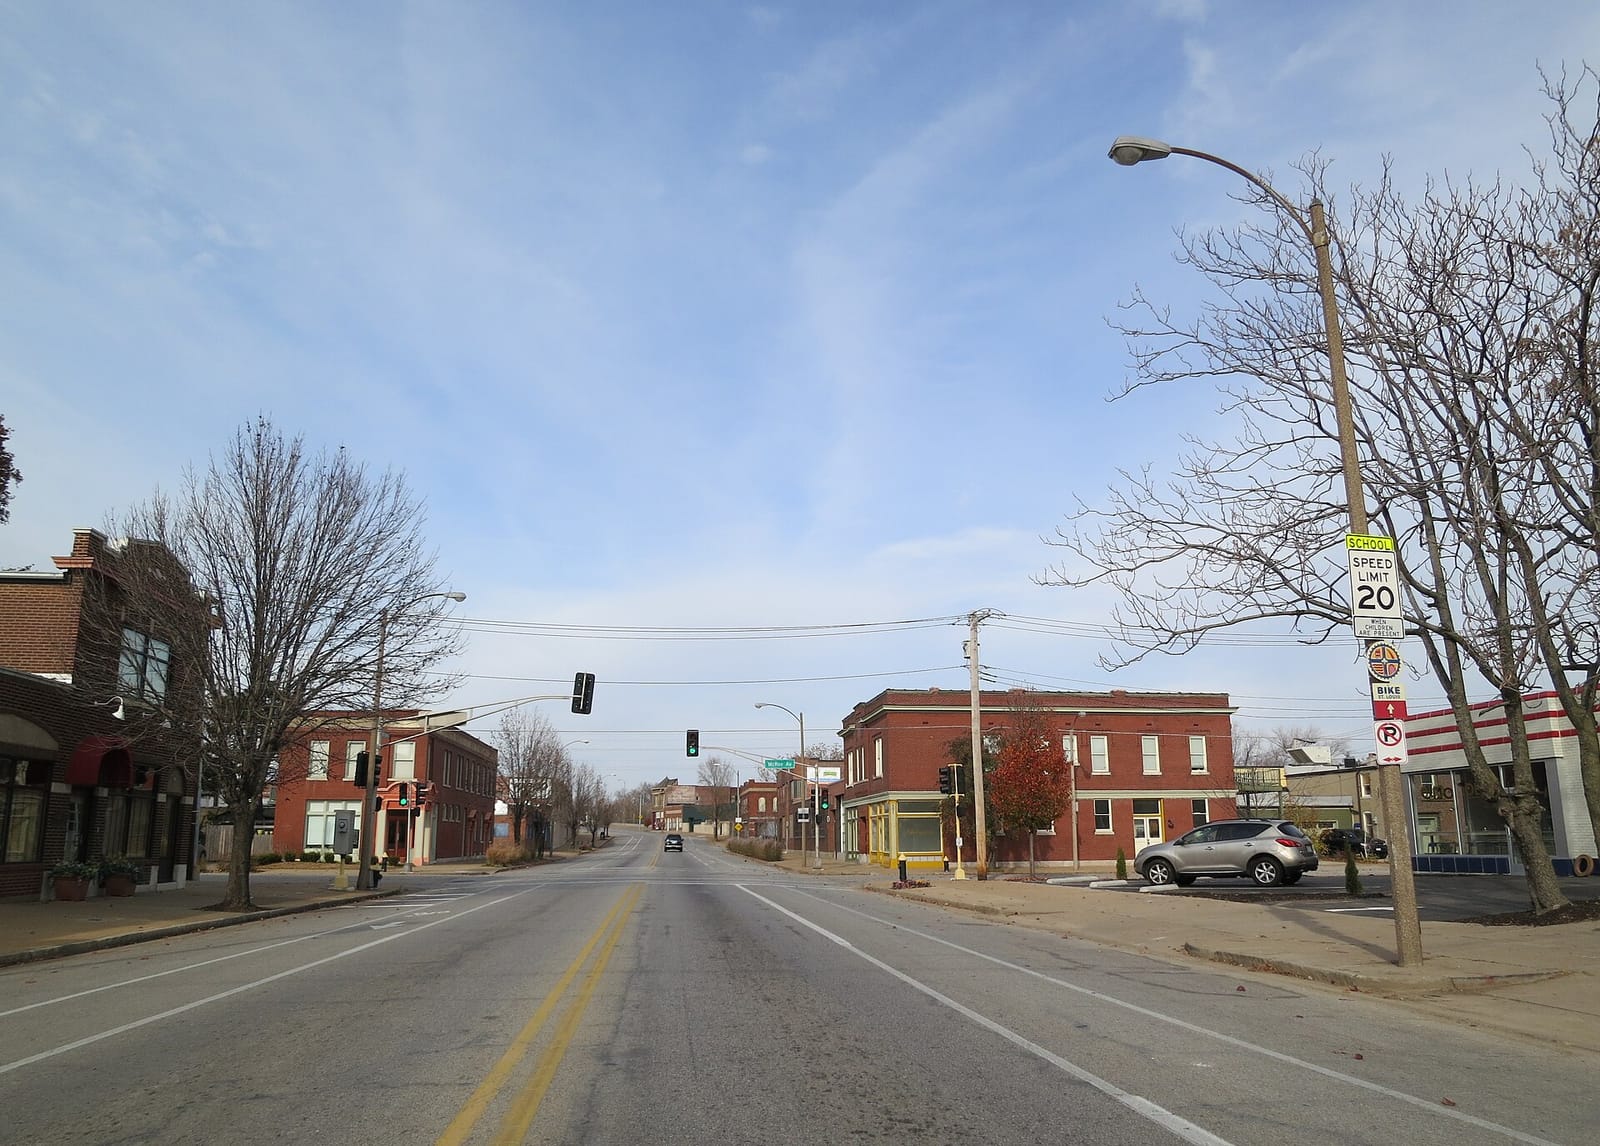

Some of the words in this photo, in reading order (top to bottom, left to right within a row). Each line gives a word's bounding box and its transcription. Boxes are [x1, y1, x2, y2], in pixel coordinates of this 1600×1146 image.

[1349, 538, 1391, 550] SCHOOL
[1353, 557, 1392, 569] SPEED
[1358, 571, 1389, 582] LIMIT
[1357, 585, 1395, 610] 20
[1383, 726, 1397, 742] P
